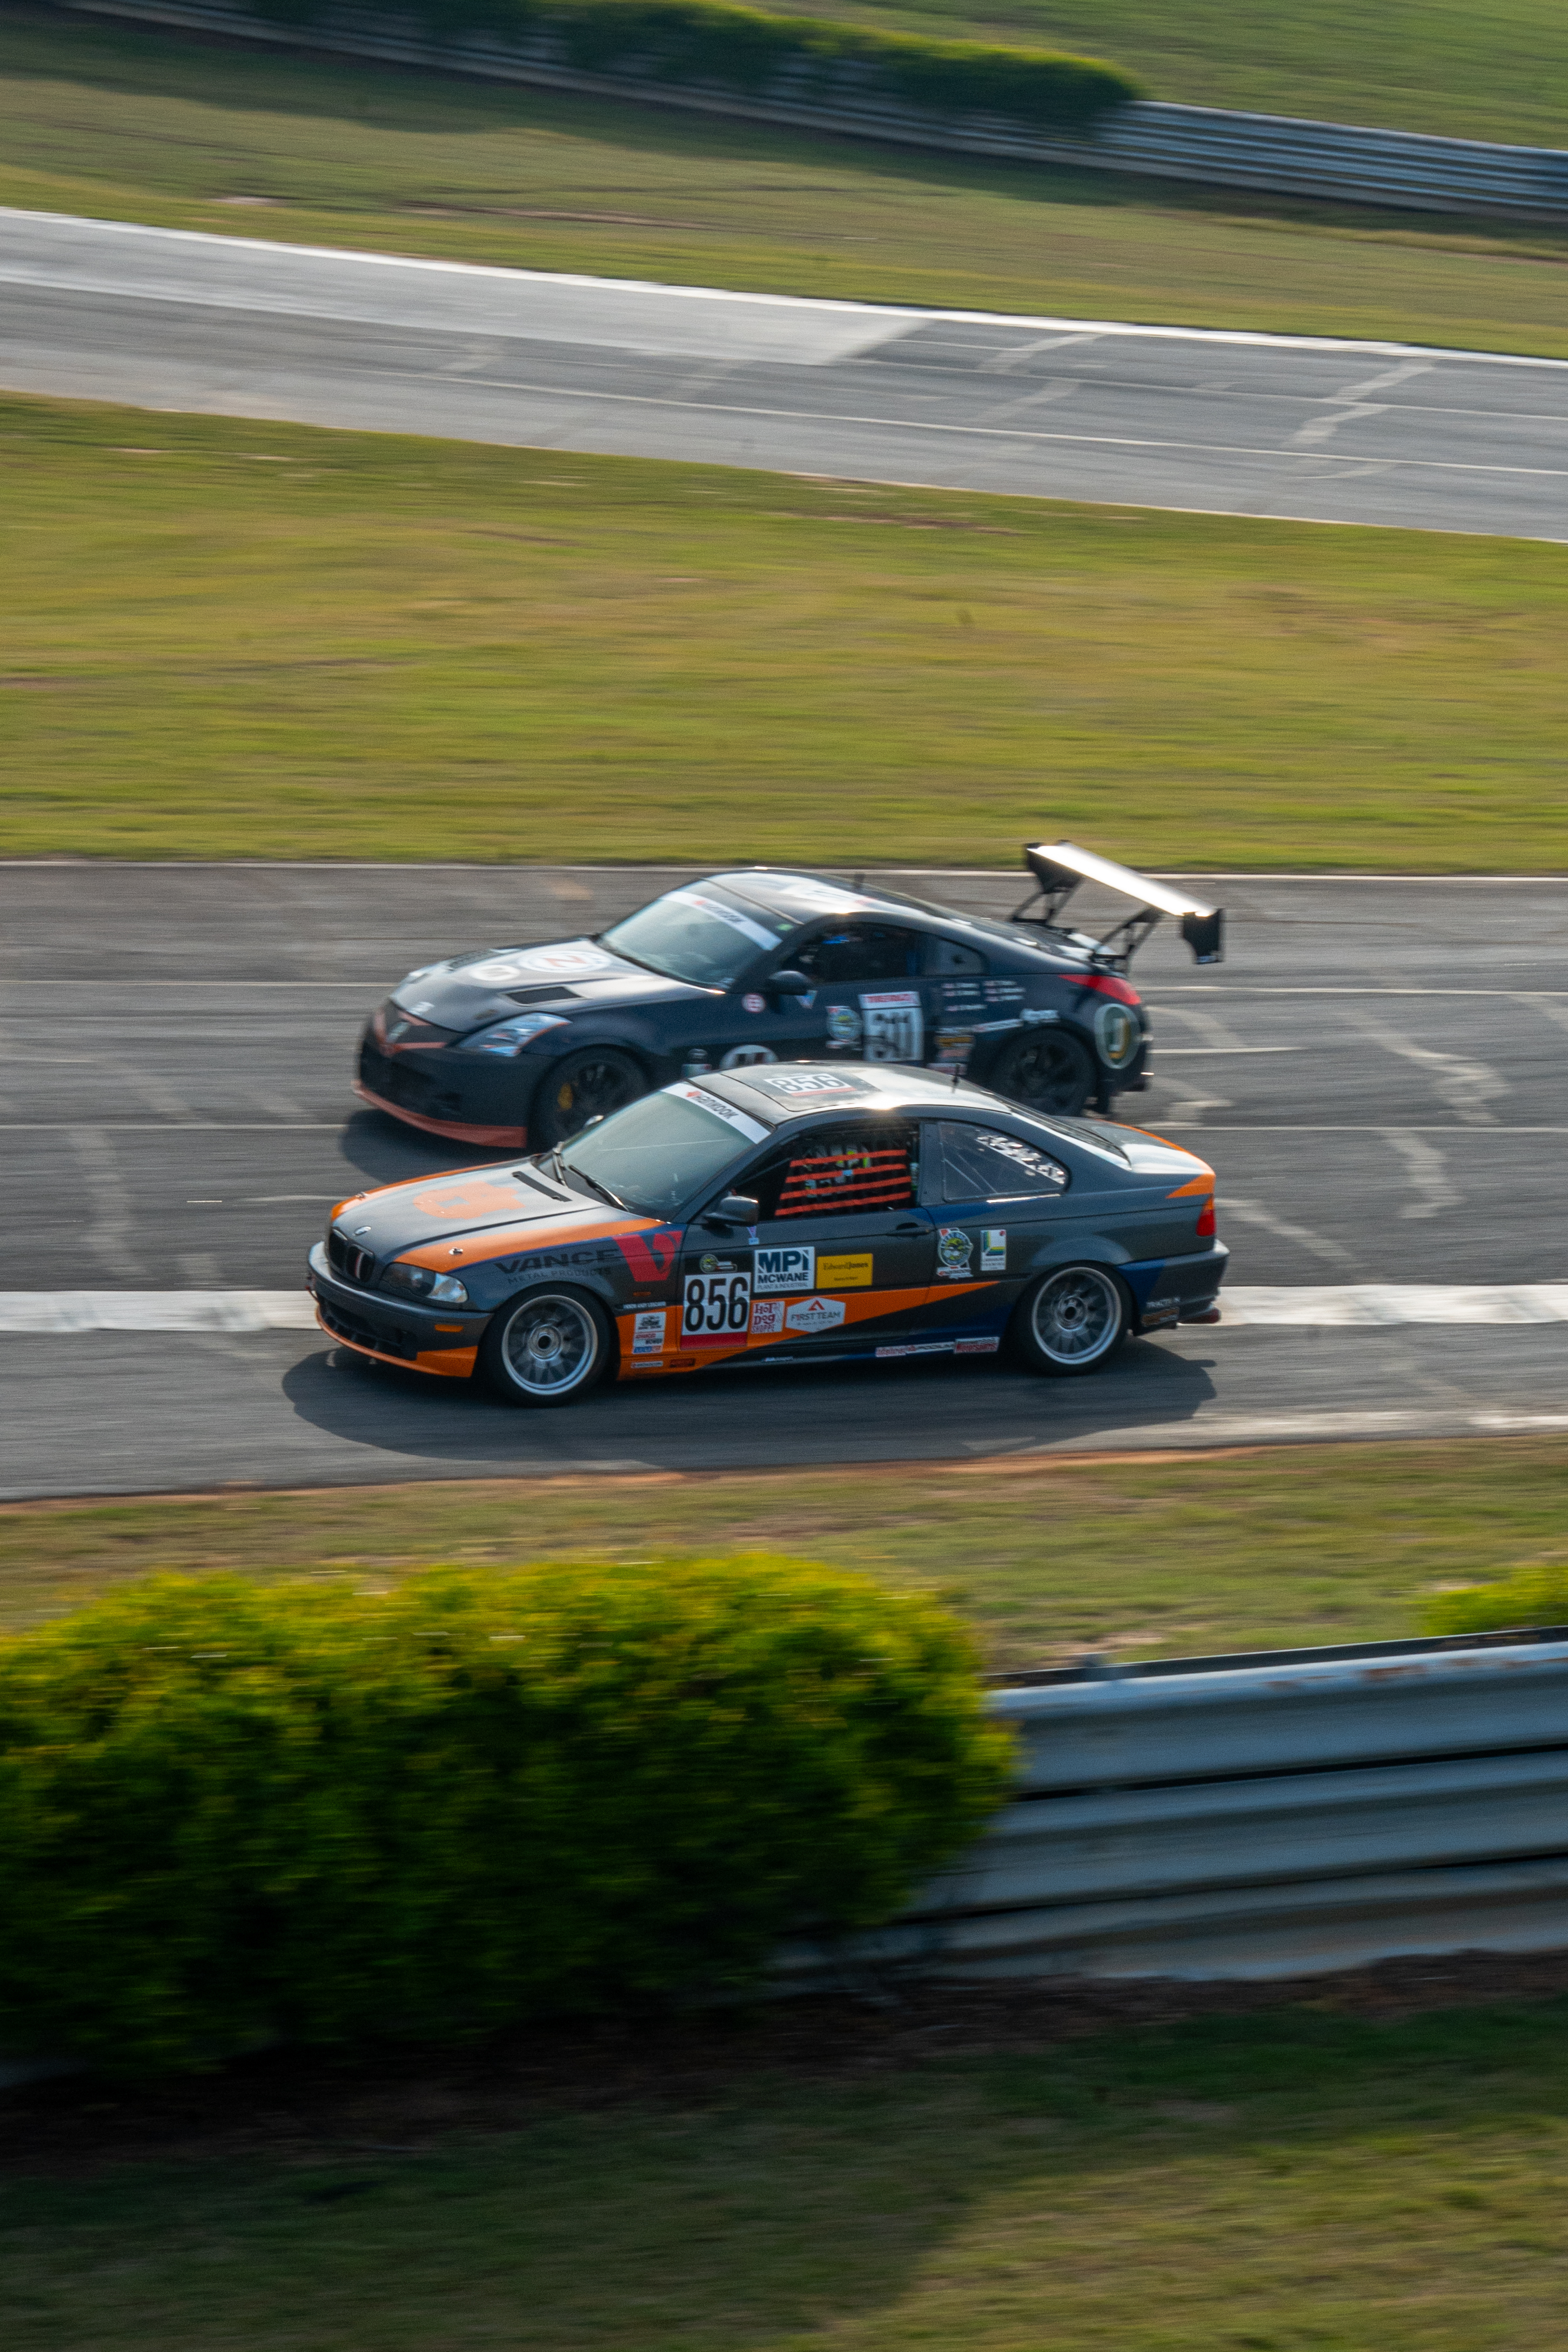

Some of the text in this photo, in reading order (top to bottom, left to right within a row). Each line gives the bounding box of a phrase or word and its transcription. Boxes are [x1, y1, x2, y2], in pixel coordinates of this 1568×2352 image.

[770, 1073, 846, 1093] 856
[493, 1249, 620, 1274] VANCE
[758, 1250, 809, 1274] MPI
[507, 1267, 613, 1284] METAL PRODUCTS
[758, 1272, 809, 1284] MCWANE
[685, 1276, 748, 1332] 856
[815, 1311, 840, 1319] TEAM
